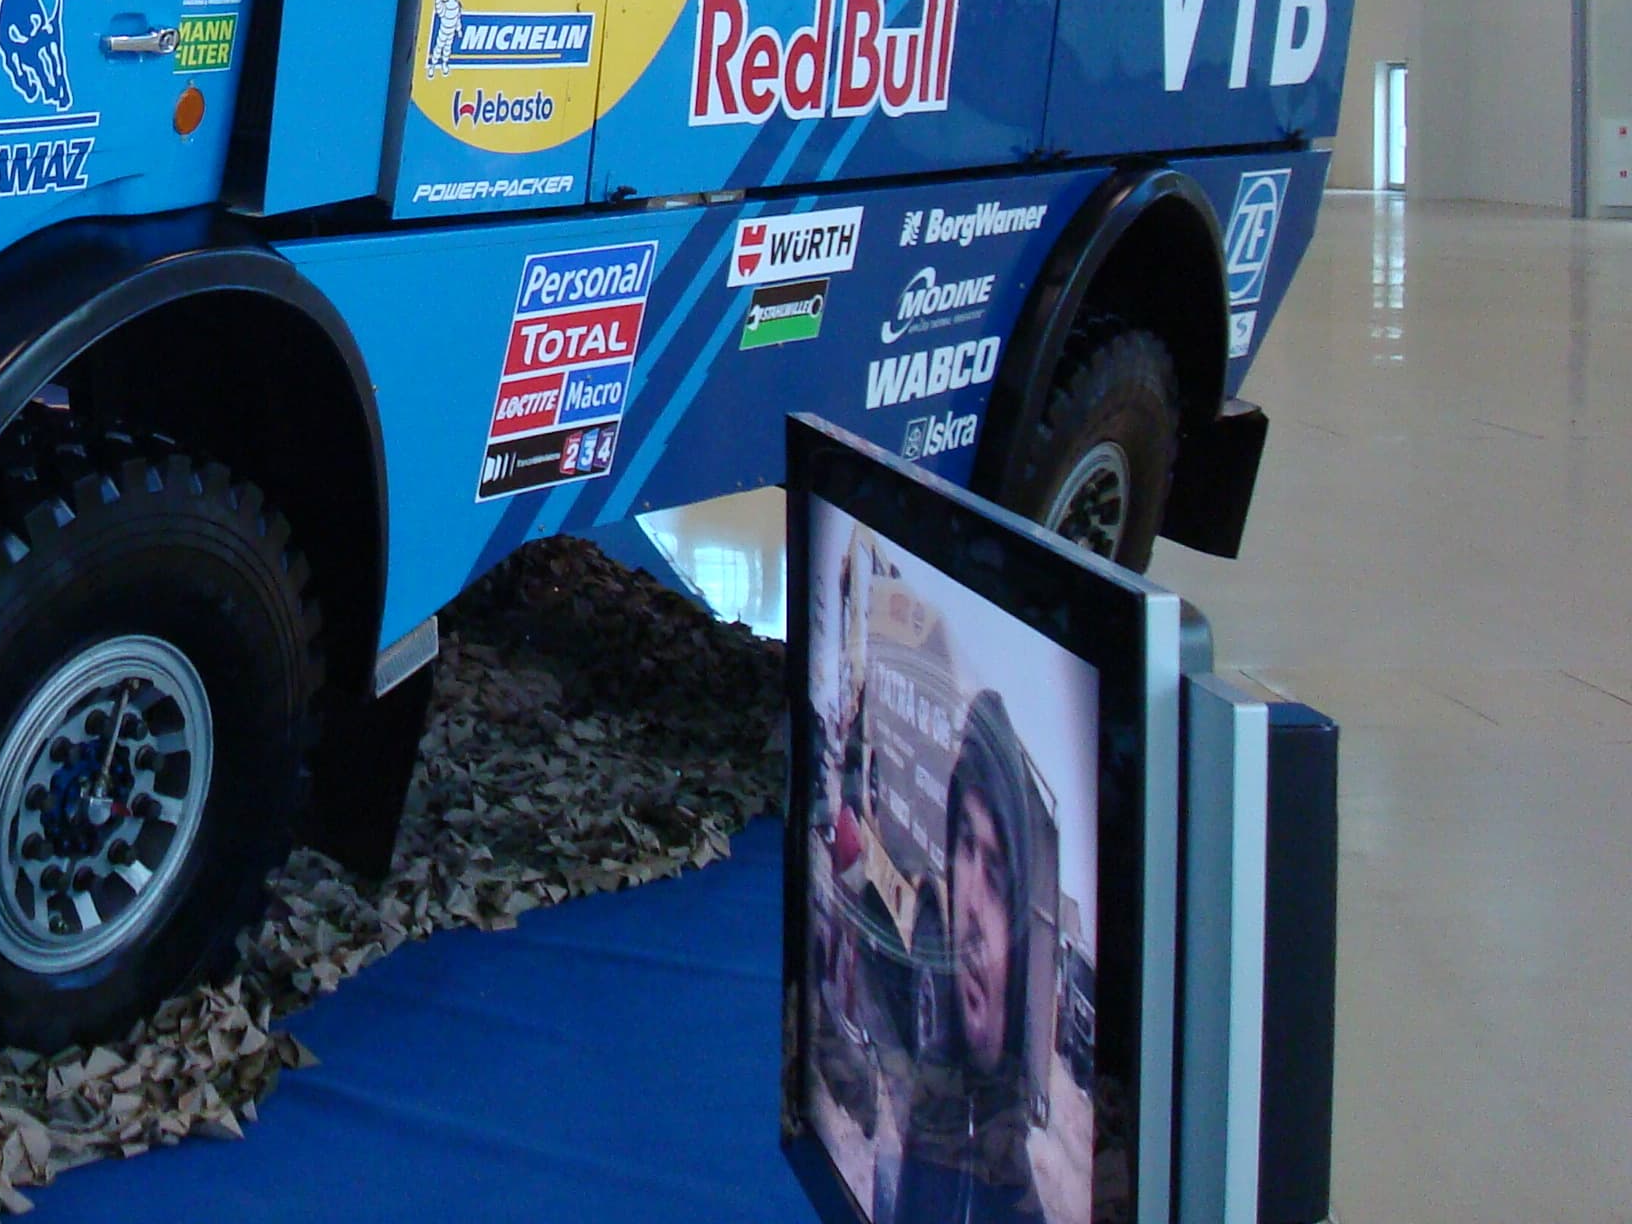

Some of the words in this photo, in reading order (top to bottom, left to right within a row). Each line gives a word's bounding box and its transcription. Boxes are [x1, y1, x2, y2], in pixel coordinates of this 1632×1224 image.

[179, 20, 234, 42] MANN
[459, 22, 588, 54] MICHELIN
[451, 87, 554, 130] Webasto
[412, 175, 575, 203] POWER-PACKER
[924, 201, 1048, 248] BorgWarner
[521, 248, 653, 308] Personal
[896, 274, 997, 321] MODINE
[519, 320, 629, 366] TOTAL
[865, 335, 1002, 411] WABCO
[495, 387, 561, 422] LOCTITE
[564, 379, 624, 412] Macro
[562, 442, 580, 470] 2
[580, 438, 597, 466] 3
[597, 436, 612, 463] 4
[922, 410, 979, 458] Iskra
